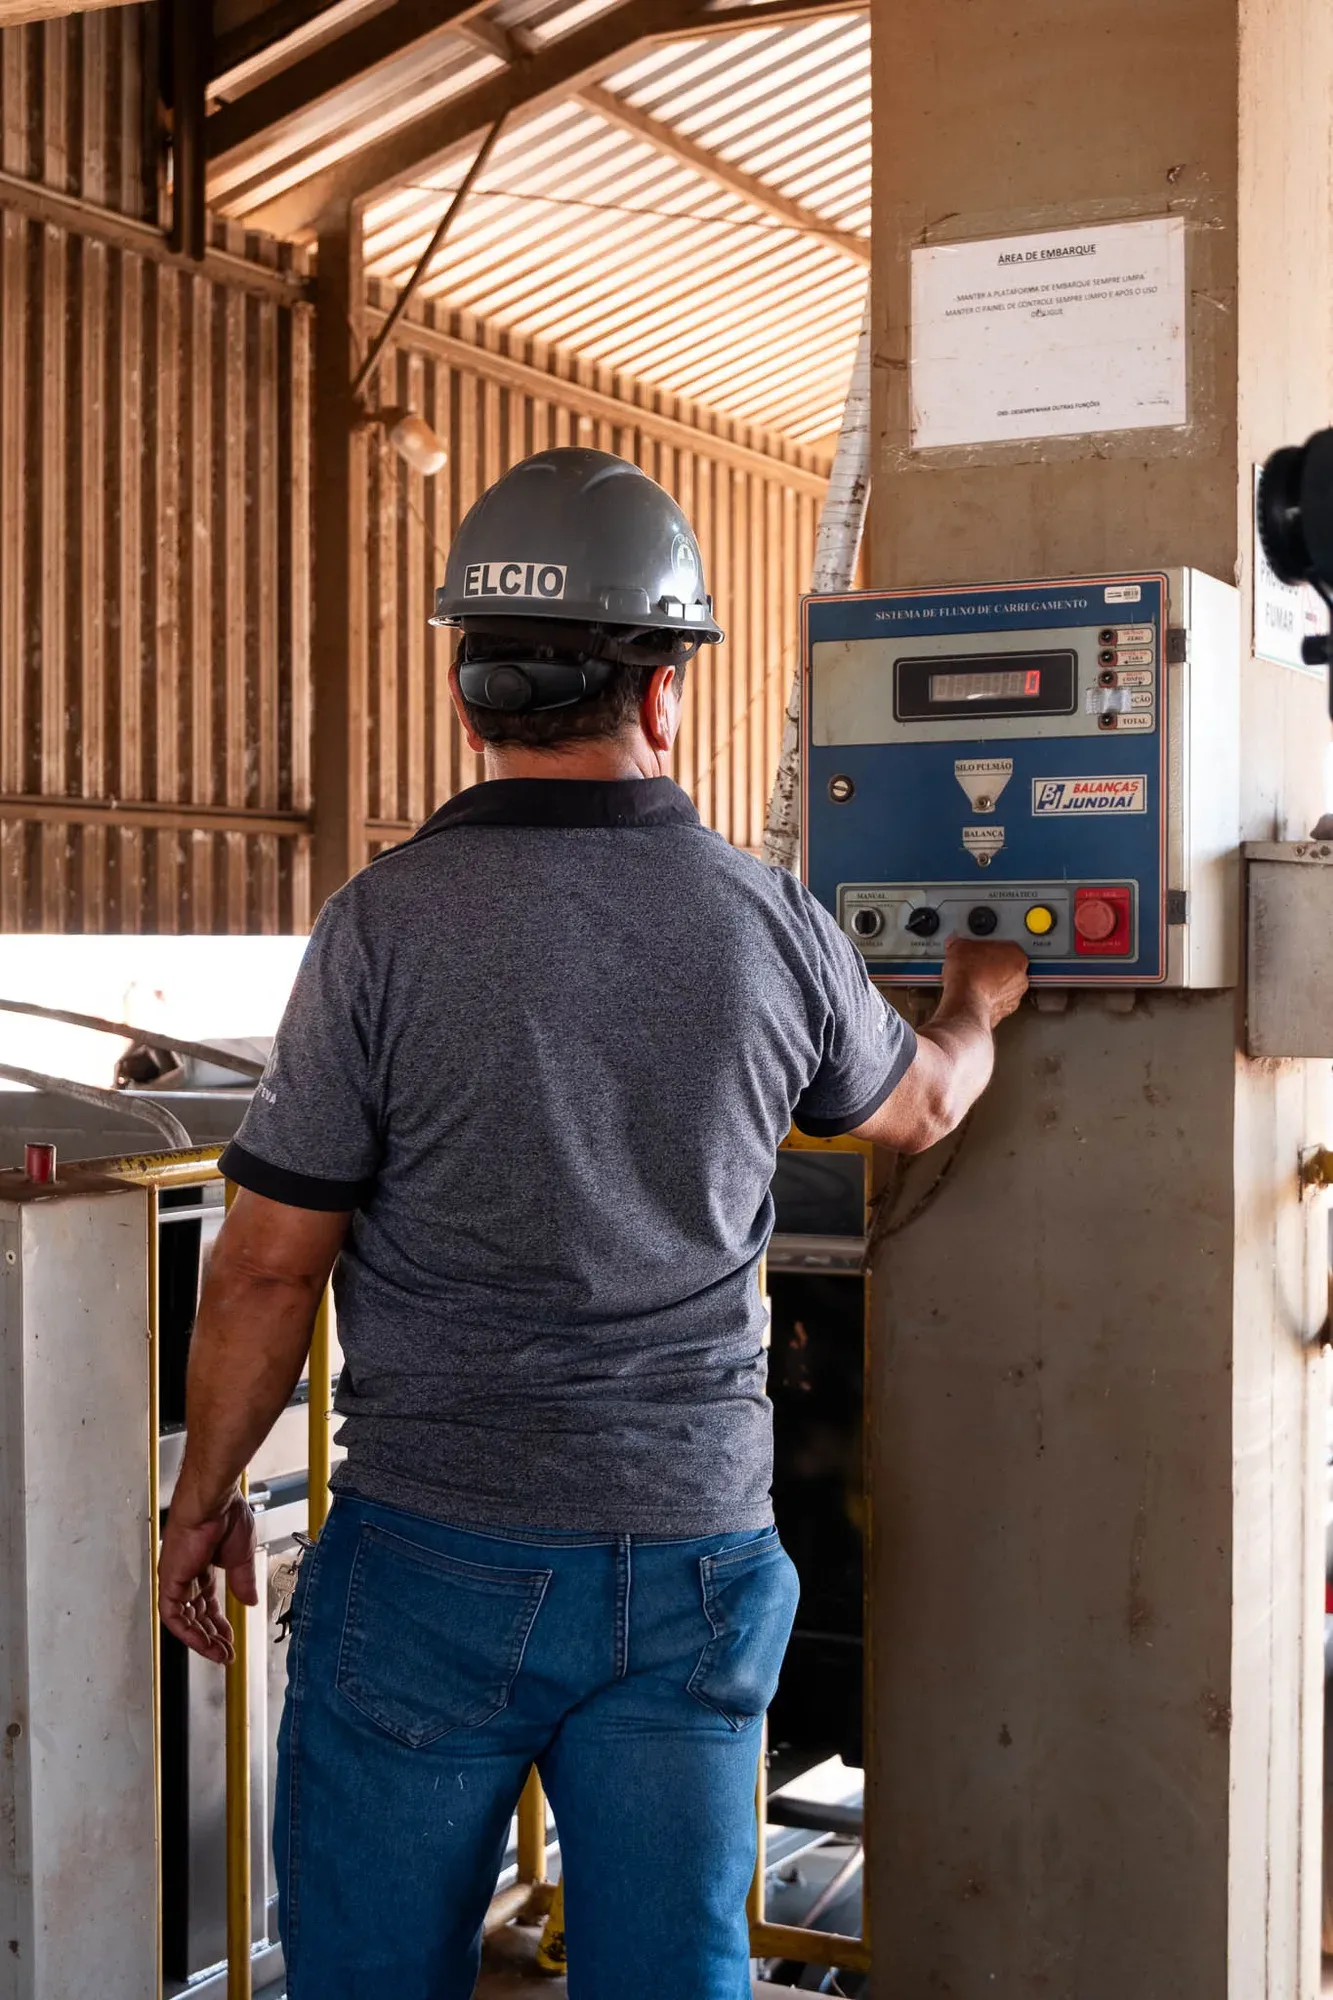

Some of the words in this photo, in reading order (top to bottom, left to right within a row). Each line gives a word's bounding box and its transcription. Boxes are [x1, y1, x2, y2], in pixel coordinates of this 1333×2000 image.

[998, 251, 1023, 264] ÁREA
[1026, 251, 1038, 260] DE
[1040, 244, 1096, 258] EMBARQUE
[957, 292, 985, 301] MANTER
[993, 286, 1039, 297] PLATAFORMA
[1041, 284, 1050, 292] DE
[1052, 279, 1091, 290] EMBARQUE
[1093, 276, 1120, 285] SEMPRE
[1122, 274, 1145, 282] LIMPA
[945, 307, 973, 316] MANTER
[982, 304, 1005, 312] PAINEL
[1007, 302, 1016, 310] DE
[1018, 298, 1053, 308] CONTROLE
[1056, 294, 1082, 304] SEMPRE
[1085, 292, 1107, 300] LIMPO
[1115, 287, 1133, 296] APÓS
[1142, 286, 1158, 294] USO
[464, 564, 564, 597] ELCIO
[875, 609, 920, 620] SISTEMA
[922, 609, 937, 618] DE
[939, 606, 975, 617] FLUXO
[977, 604, 990, 615] DE
[994, 599, 1088, 614] CARREGAMENTO
[955, 763, 974, 772] SILO
[976, 761, 1012, 771] PULMÃO
[1073, 781, 1139, 795] BALANÇAS
[1063, 792, 1135, 809] JUNDIAÍ
[964, 829, 1004, 839] BALANÇA
